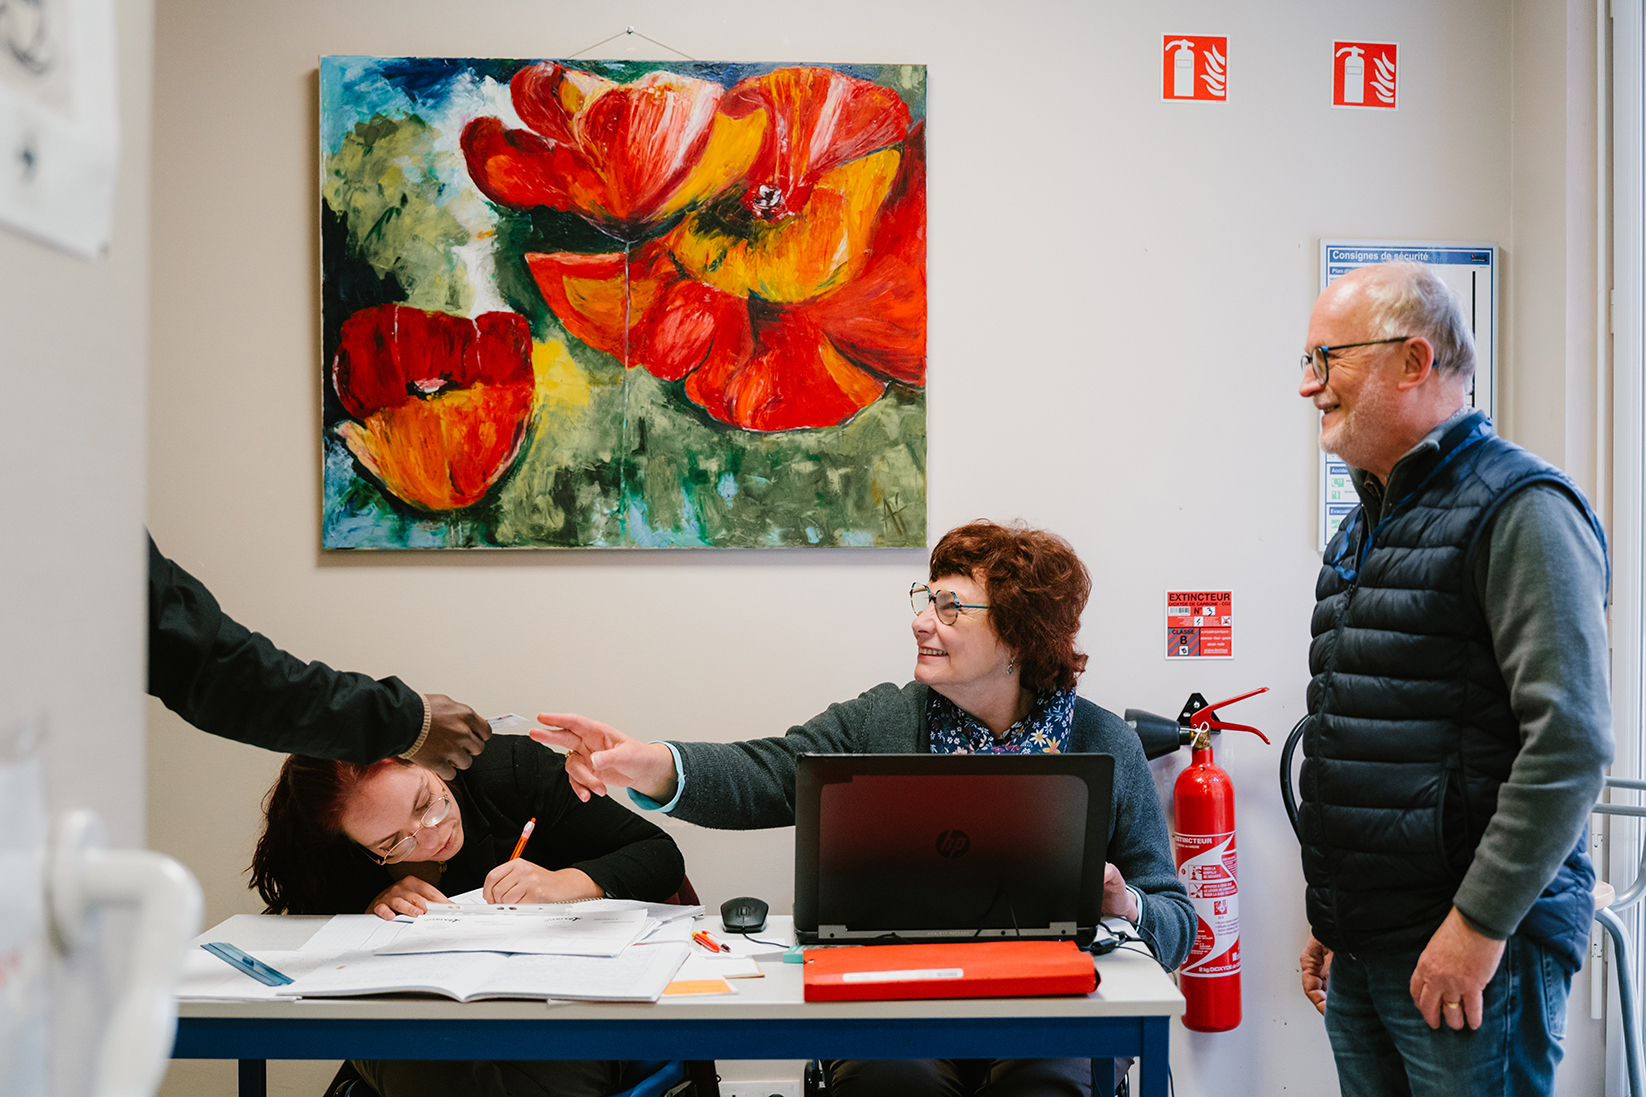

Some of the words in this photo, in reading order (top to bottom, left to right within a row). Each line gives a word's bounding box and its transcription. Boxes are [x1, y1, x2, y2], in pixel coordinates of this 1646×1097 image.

[1332, 250, 1379, 262] Consignes
[1380, 251, 1392, 260] de
[1393, 251, 1429, 261] sécurité
[1169, 593, 1230, 601] EXTINCTEUR
[1180, 635, 1188, 645] B
[940, 830, 967, 857] hp
